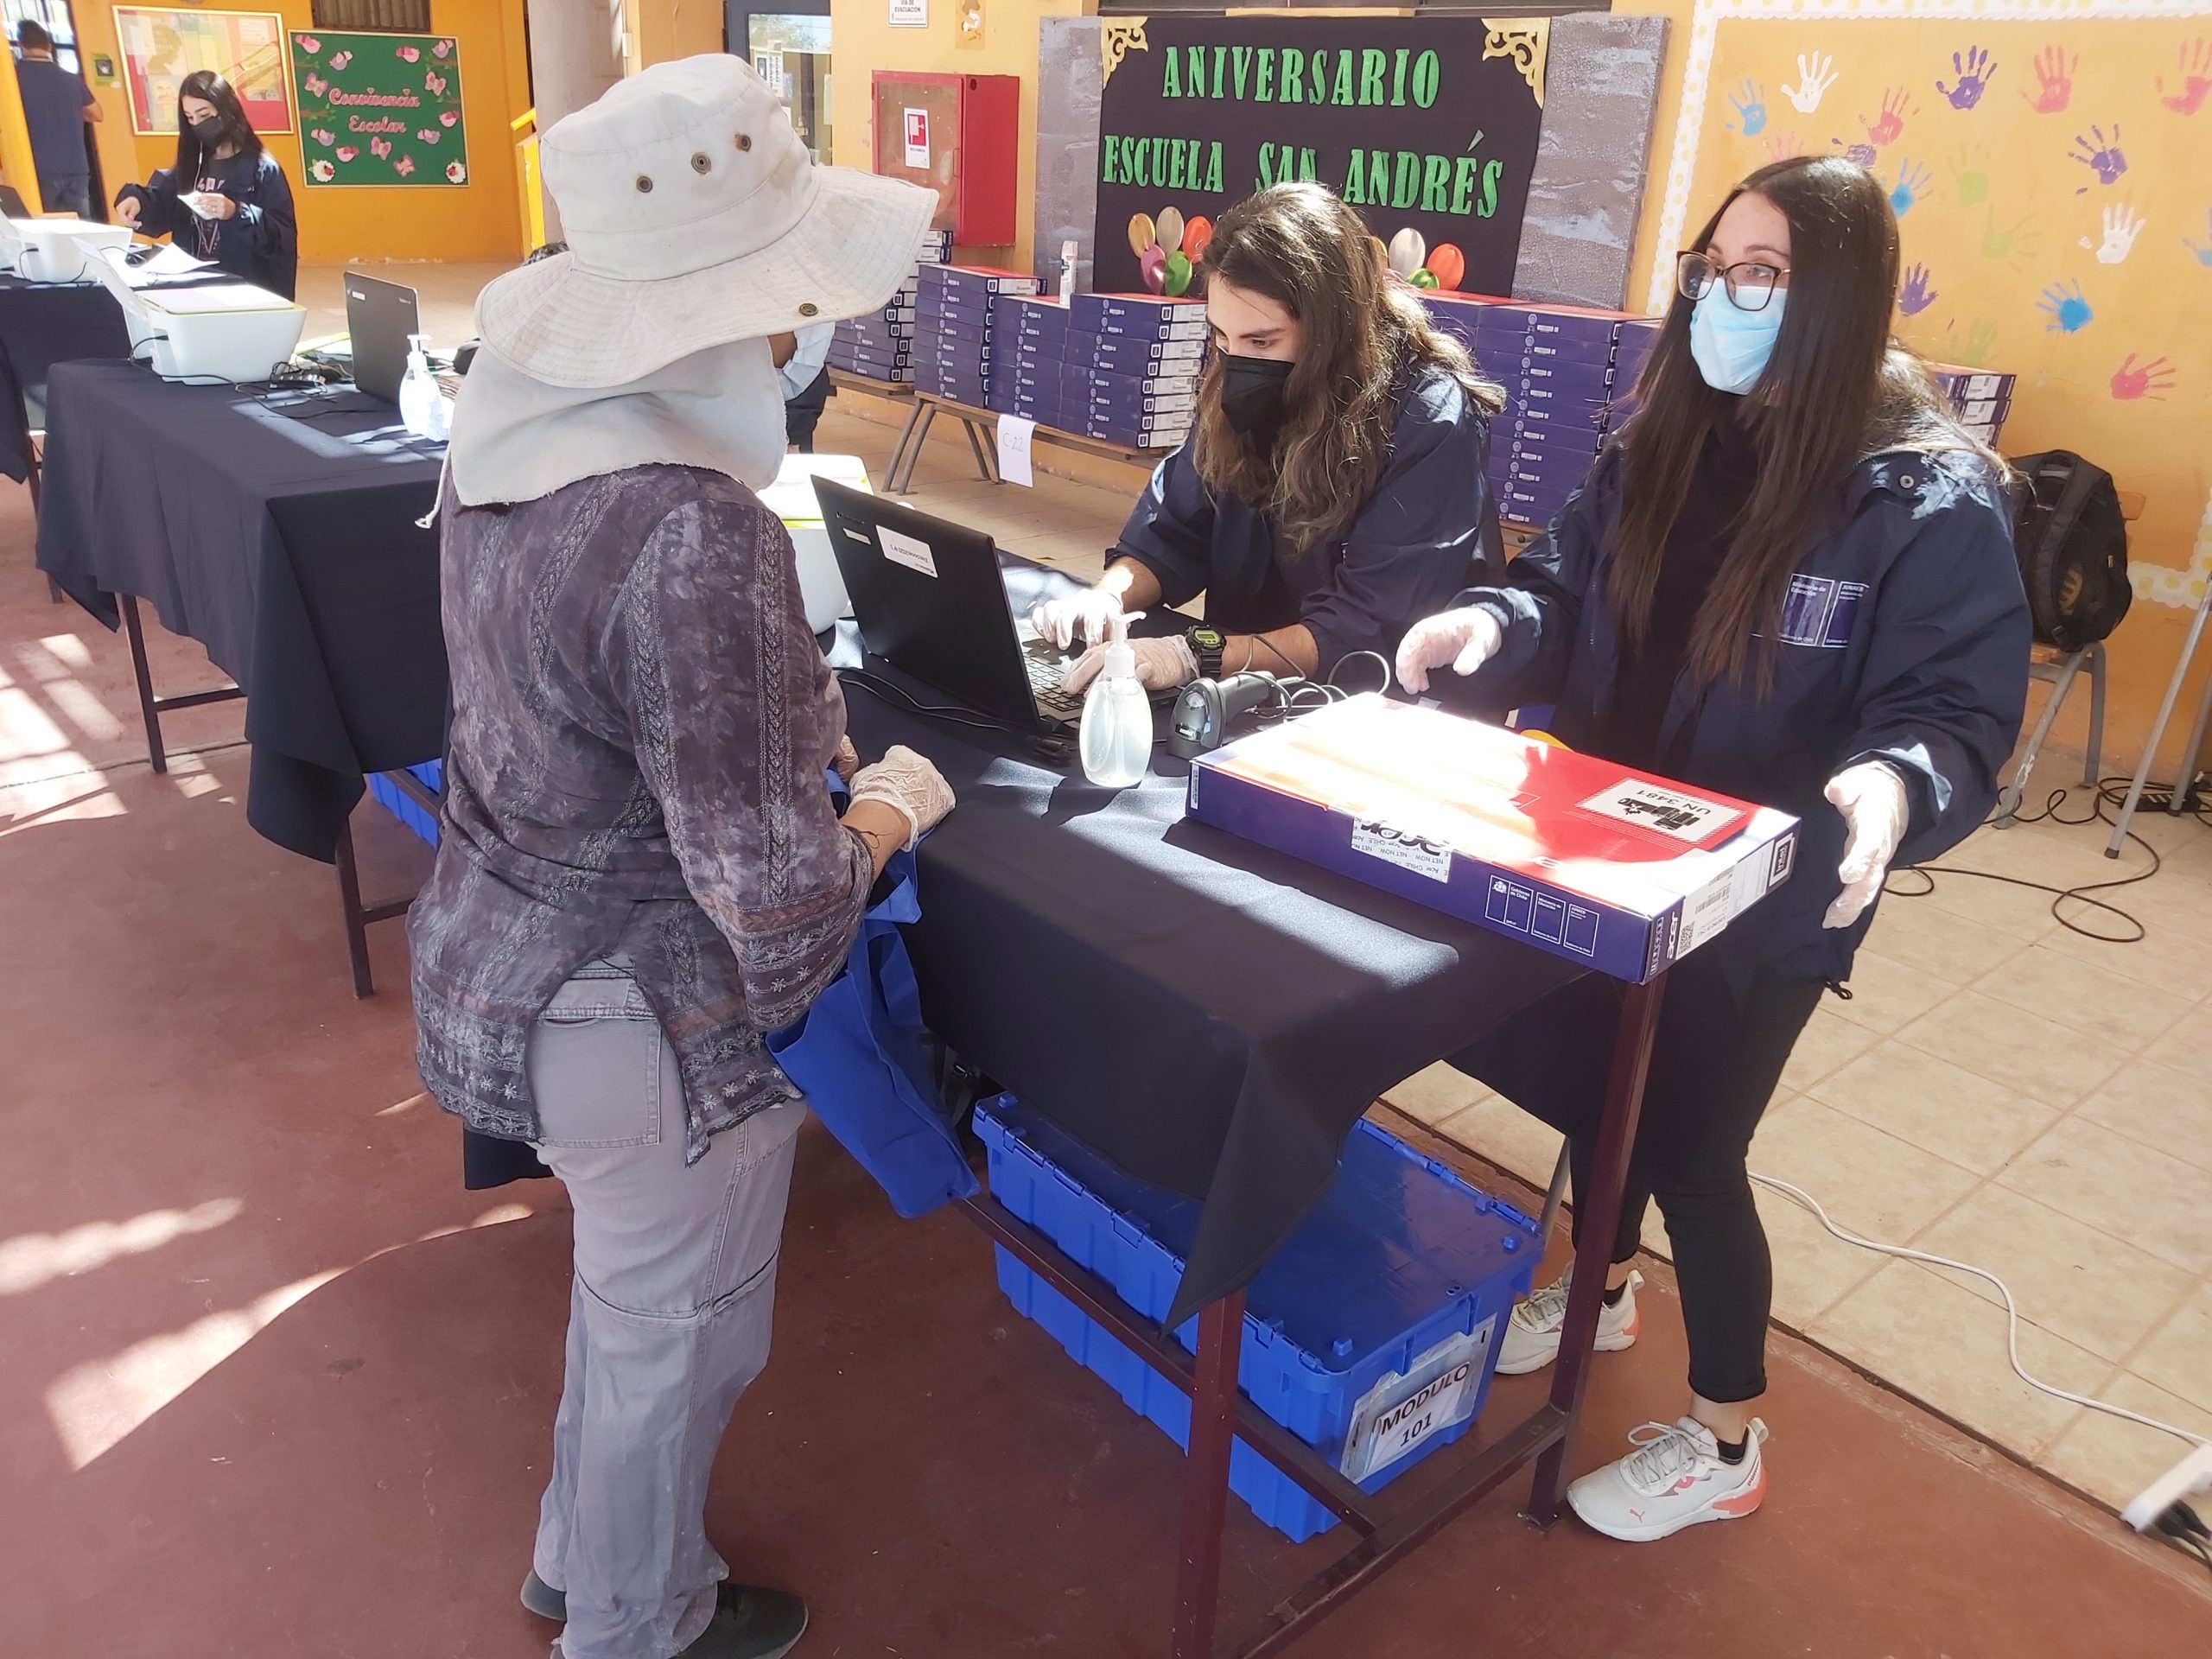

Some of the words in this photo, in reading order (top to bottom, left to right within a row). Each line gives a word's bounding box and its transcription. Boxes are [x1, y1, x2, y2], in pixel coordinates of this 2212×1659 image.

[1162, 46, 1440, 109] ANIVERSARIO
[347, 115, 407, 134] Escolar
[1102, 134, 1225, 194] ESCUELA
[1255, 141, 1318, 193] SAN
[1343, 129, 1504, 219] ANDRÉS
[1637, 790, 1679, 804] 3481
[1682, 803, 1711, 815] UN
[1414, 855, 1431, 864] NOW
[1667, 911, 1679, 959] acer
[1382, 1363, 1469, 1435] MODULO
[1401, 1412, 1432, 1447] 101
